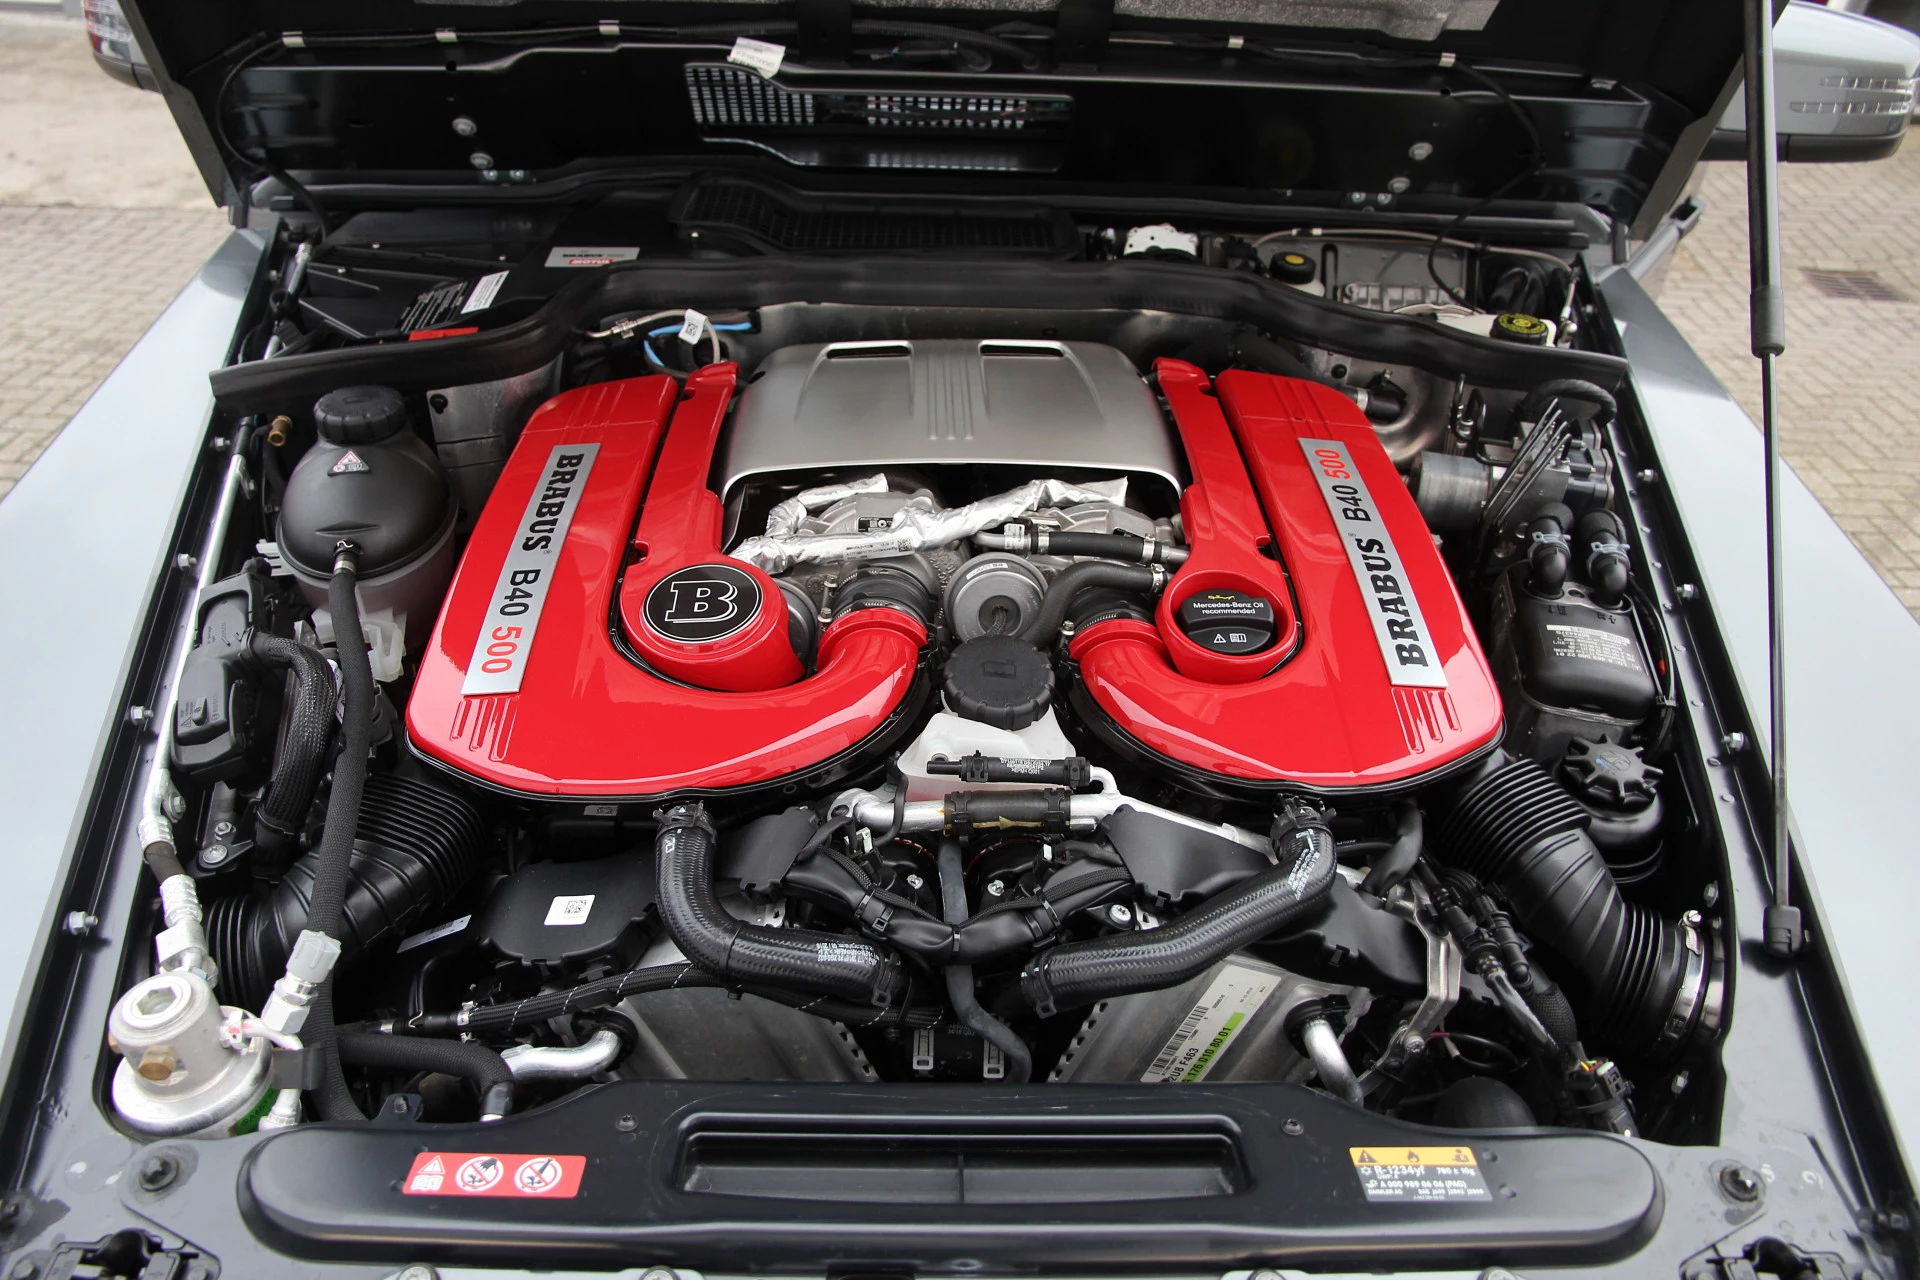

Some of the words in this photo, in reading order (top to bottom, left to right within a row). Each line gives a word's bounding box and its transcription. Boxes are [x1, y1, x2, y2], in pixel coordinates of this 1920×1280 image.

[1314, 448, 1351, 480] 500
[1331, 484, 1372, 522] B40
[499, 568, 542, 617] B40
[664, 580, 738, 624] B
[481, 625, 523, 674] 500
[1179, 1048, 1199, 1066] F463
[1187, 1064, 1204, 1077] 176
[1198, 1049, 1215, 1063] 010
[1209, 1037, 1223, 1048] 80
[1218, 1026, 1232, 1037] 01
[1374, 1165, 1425, 1177] R-1234yf
[1460, 1167, 1476, 1176] 10g
[1387, 1180, 1403, 1188] 000
[1404, 1180, 1420, 1188] 989
[1421, 1180, 1432, 1188] 06
[1433, 1180, 1444, 1188] 06
